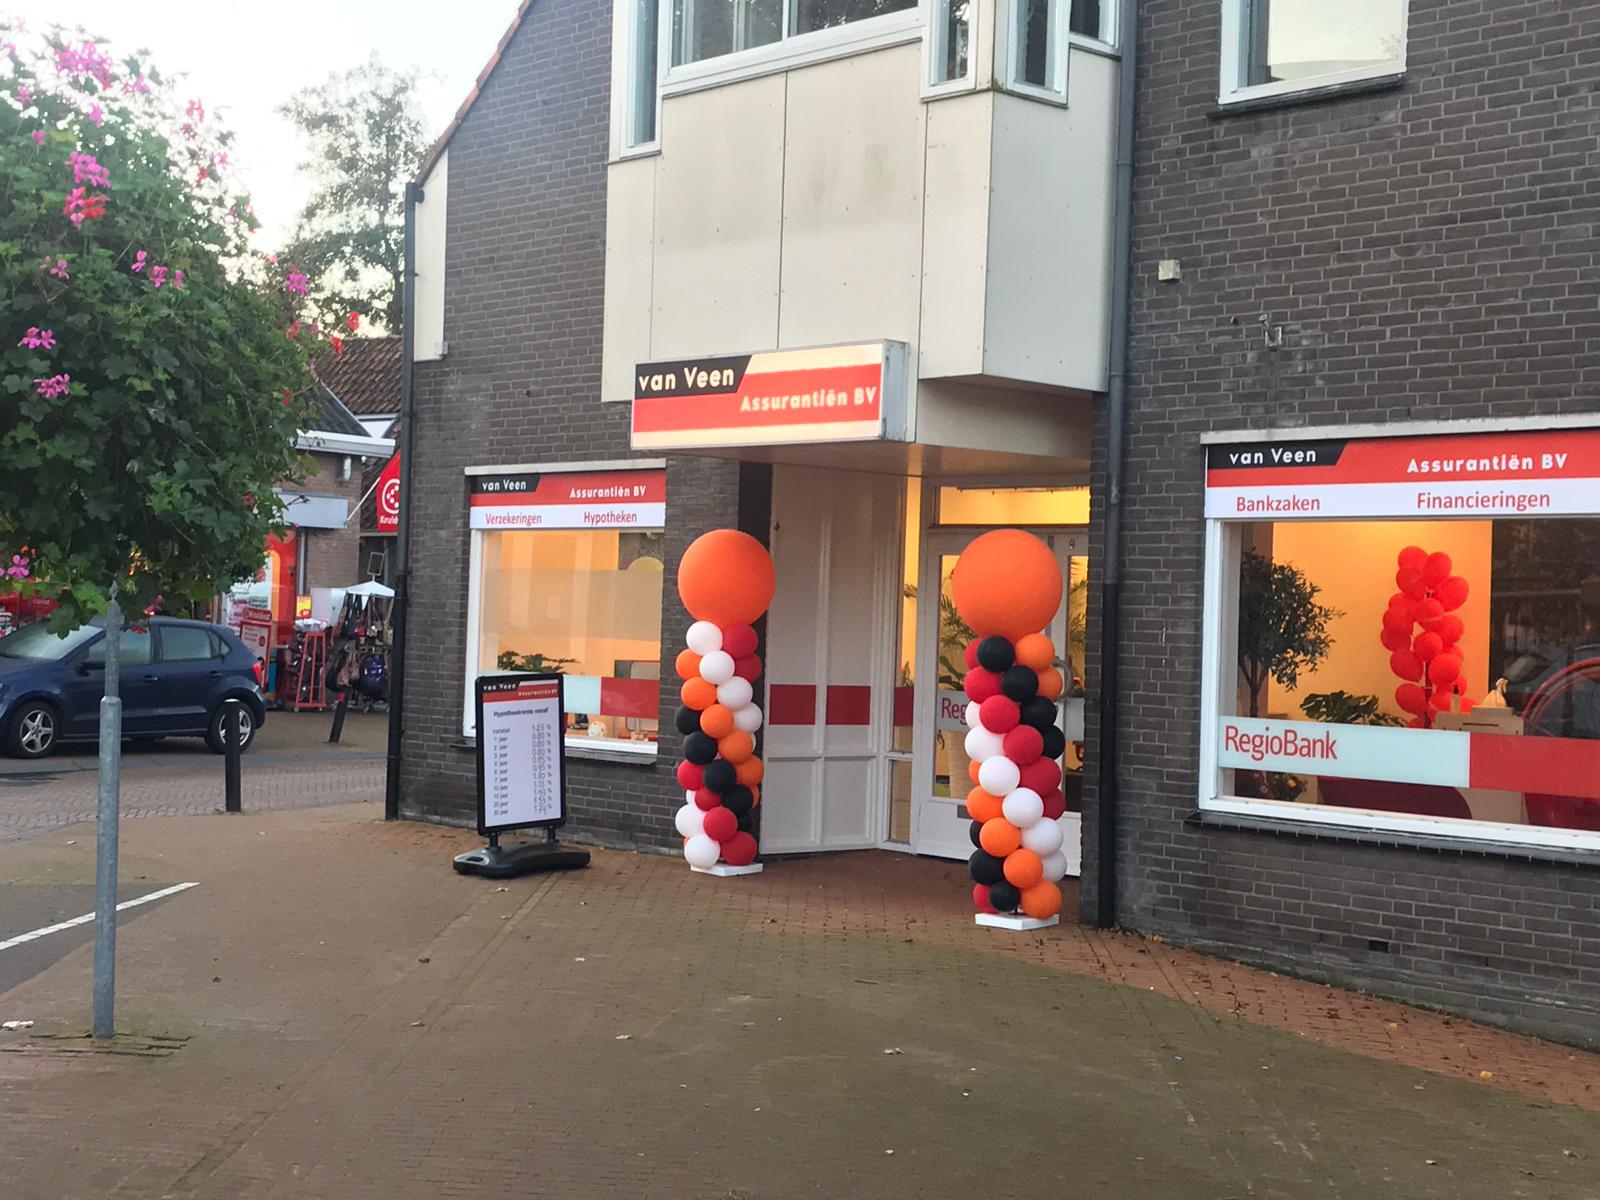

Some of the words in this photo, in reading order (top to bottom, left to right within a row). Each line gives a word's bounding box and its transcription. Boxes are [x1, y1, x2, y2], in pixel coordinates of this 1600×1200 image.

[638, 373, 676, 392] van
[683, 366, 734, 389] Veen
[853, 386, 877, 405] BV
[1229, 451, 1263, 465] van
[1271, 448, 1316, 463] Veen
[1407, 453, 1533, 473] Assurantiën
[1541, 452, 1567, 470] BV
[482, 481, 500, 491] van
[503, 479, 527, 490] Veen
[633, 485, 646, 497] BV
[1236, 494, 1320, 512] Bankzaken
[1417, 490, 1550, 512] Financieringen
[485, 511, 542, 527] Verzekeringen
[583, 510, 637, 526] Hypotheken
[1225, 724, 1338, 761] RegioBank
